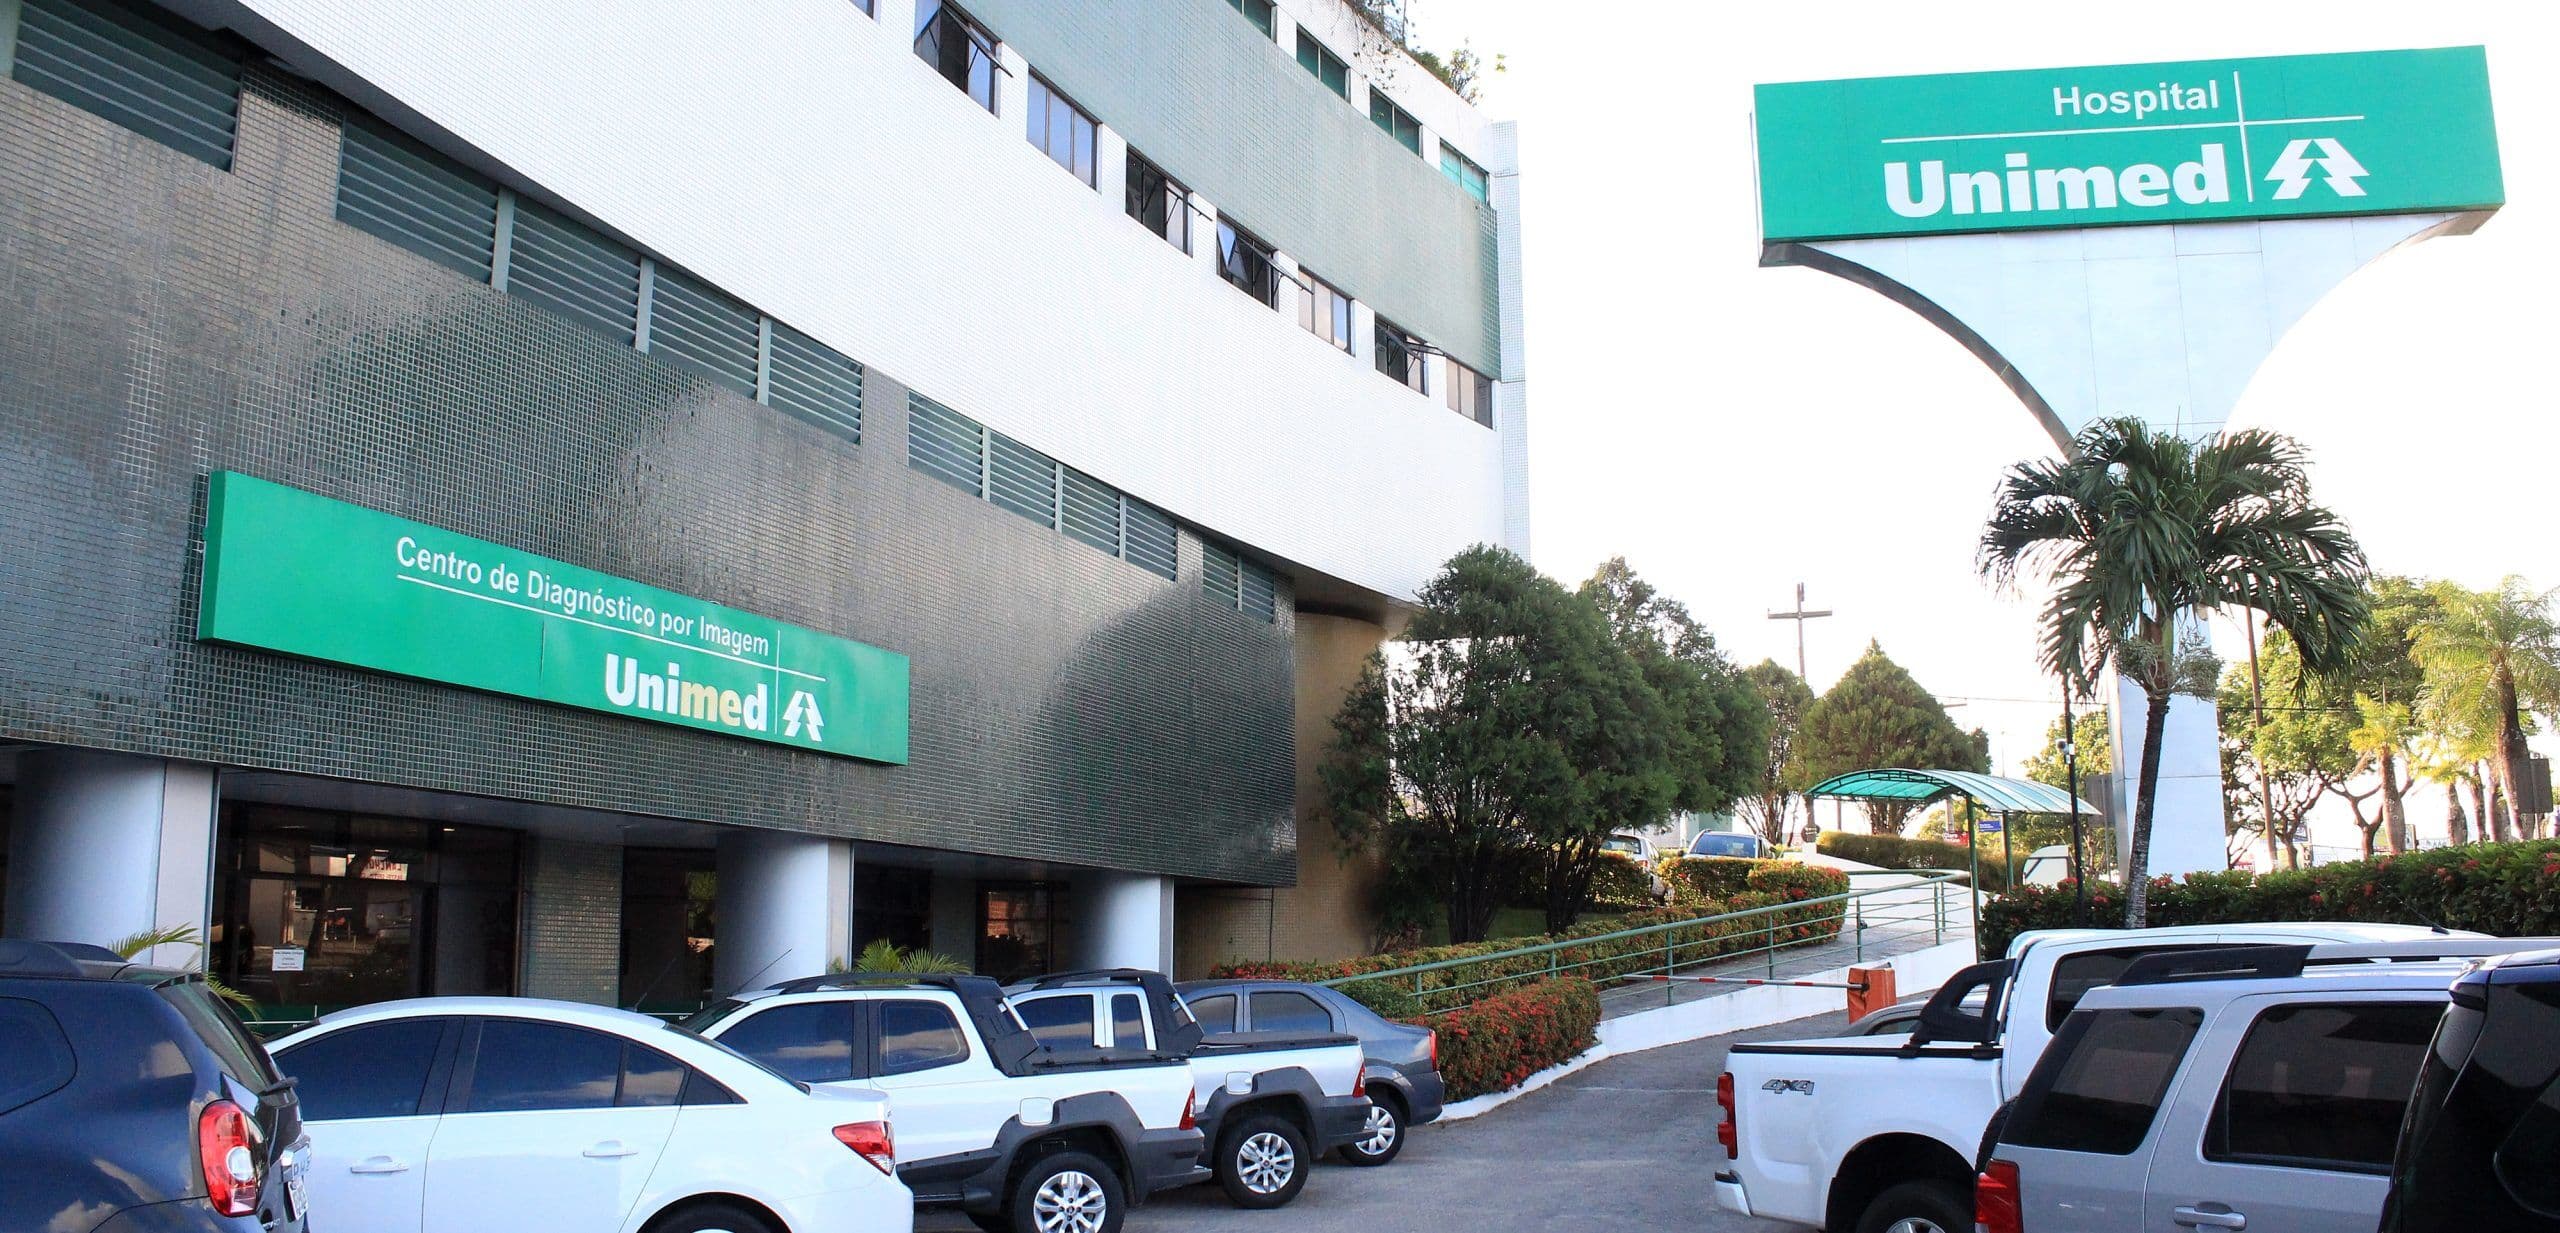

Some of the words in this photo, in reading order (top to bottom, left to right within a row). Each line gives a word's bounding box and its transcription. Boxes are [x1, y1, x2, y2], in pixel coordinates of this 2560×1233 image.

[2053, 80, 2219, 120] Hospital
[1884, 144, 2229, 217] Unimed
[396, 537, 482, 584] Centro
[489, 564, 520, 594] de
[528, 571, 655, 630] Diagnóstico
[660, 612, 694, 637] por
[699, 614, 769, 657] Imagem
[605, 653, 767, 732] Unimed
